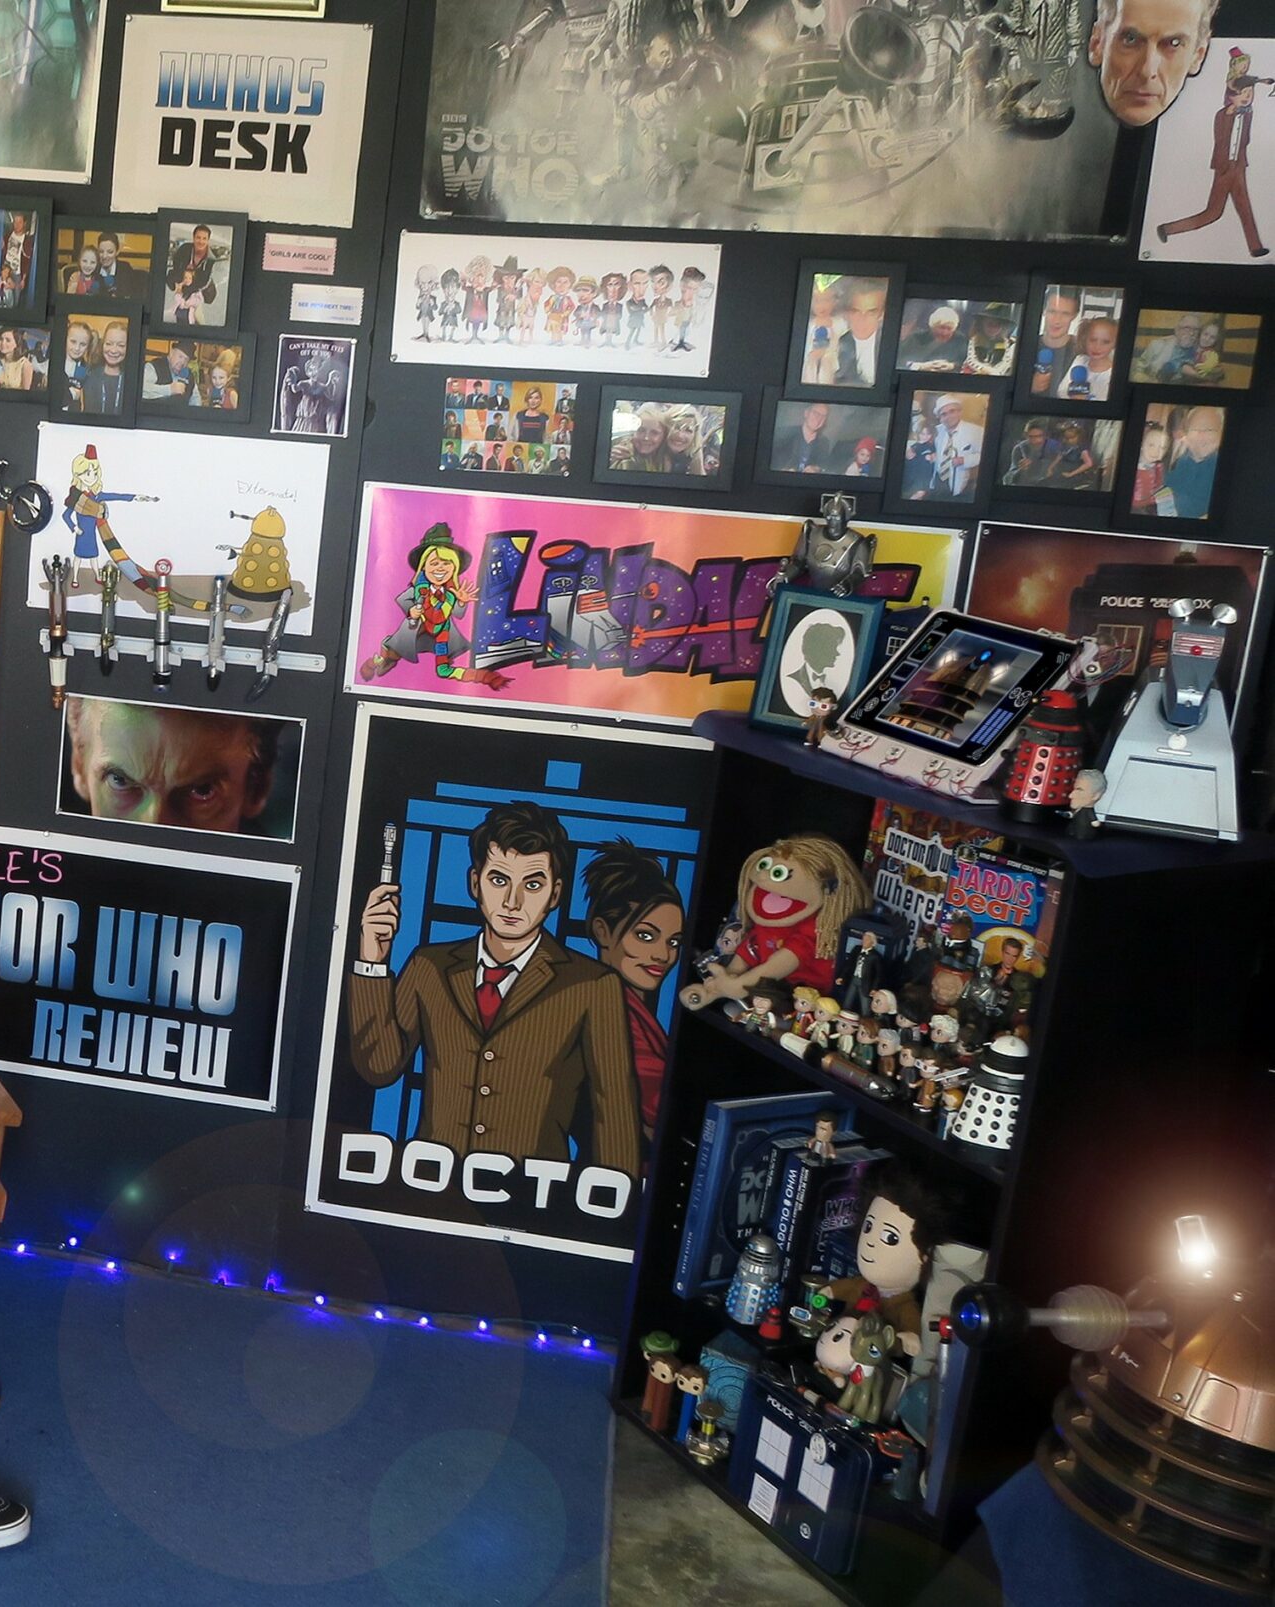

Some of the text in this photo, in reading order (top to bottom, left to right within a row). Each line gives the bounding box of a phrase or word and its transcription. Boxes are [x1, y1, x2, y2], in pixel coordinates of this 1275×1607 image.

[158, 117, 311, 174] DESK
[441, 126, 578, 155] DOCTOR
[441, 154, 579, 201] WHO
[292, 252, 307, 260] ARE
[1100, 596, 1145, 608] POLICE
[1194, 599, 1214, 609] OX
[888, 832, 926, 869] DOCTOR
[93, 905, 243, 1016] WHO
[29, 998, 232, 1088] REVIEW
[338, 1133, 646, 1219] DOCTO
